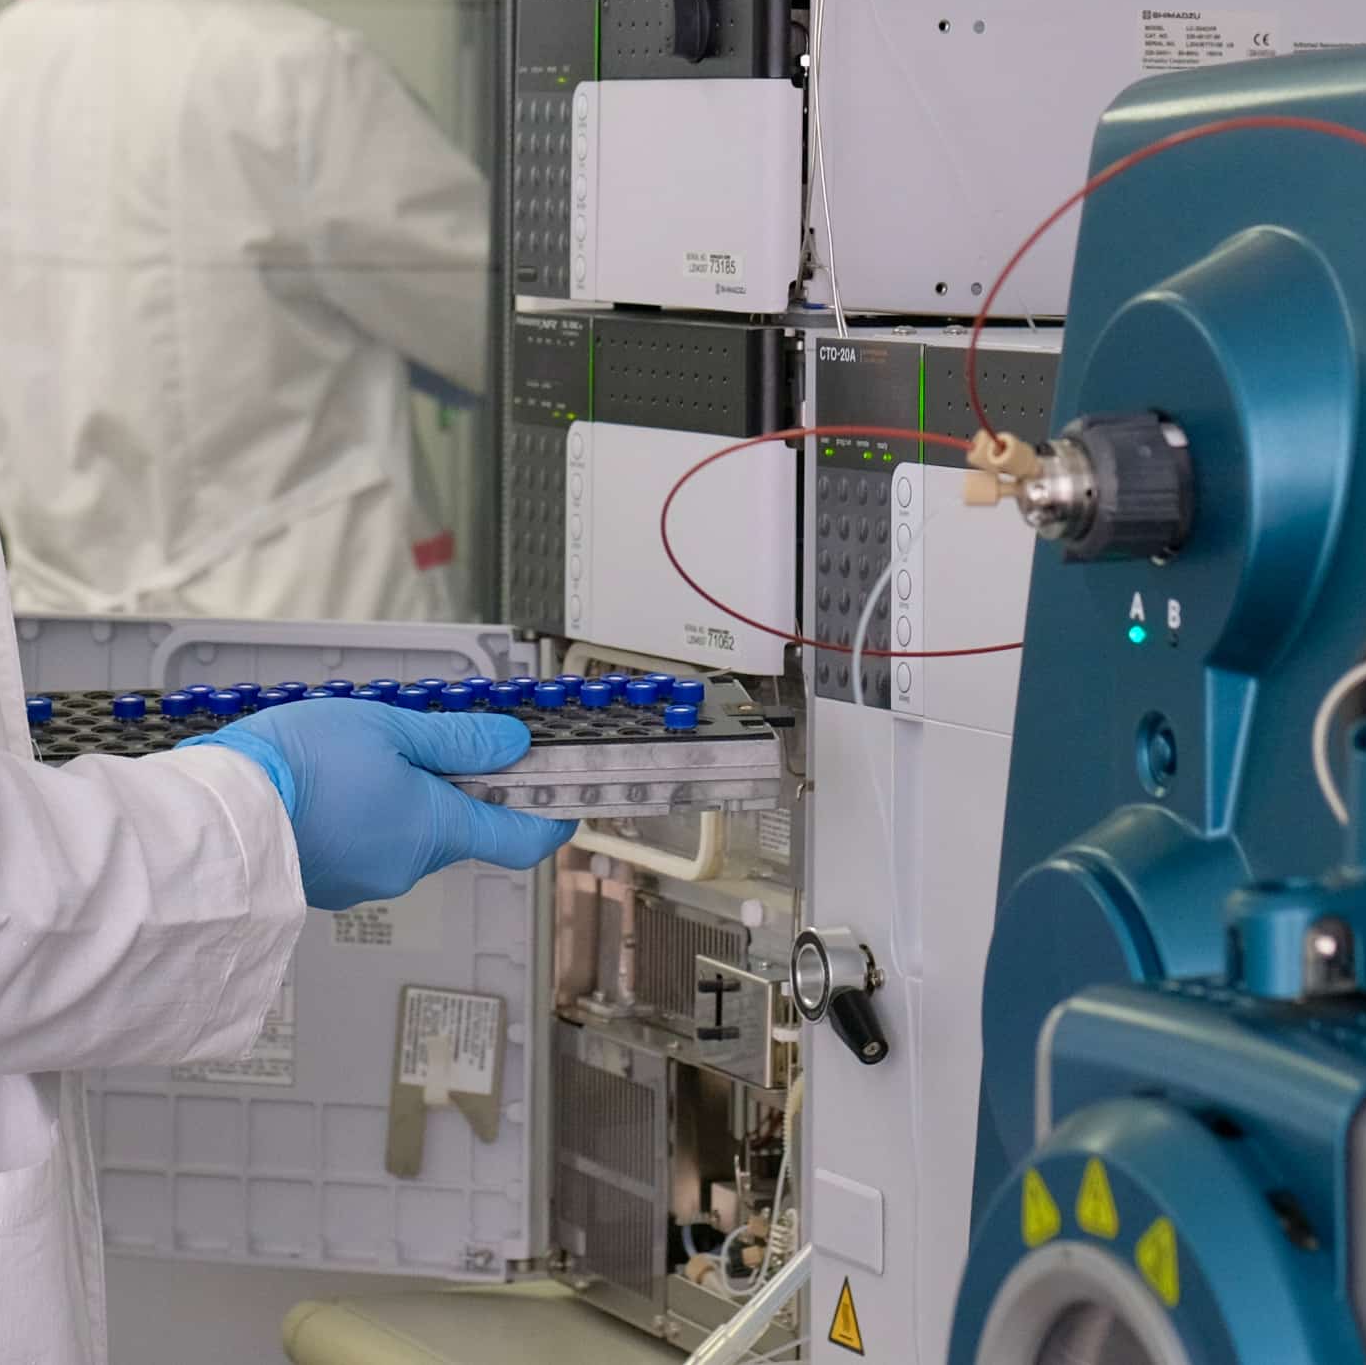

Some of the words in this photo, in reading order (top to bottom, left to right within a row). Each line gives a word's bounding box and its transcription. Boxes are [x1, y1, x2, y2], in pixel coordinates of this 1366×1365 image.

[1152, 11, 1201, 21] SHIMADZU
[709, 258, 736, 275] 73185
[819, 346, 856, 363] CTO-20A
[1129, 591, 1146, 623] A
[1167, 598, 1181, 630] B
